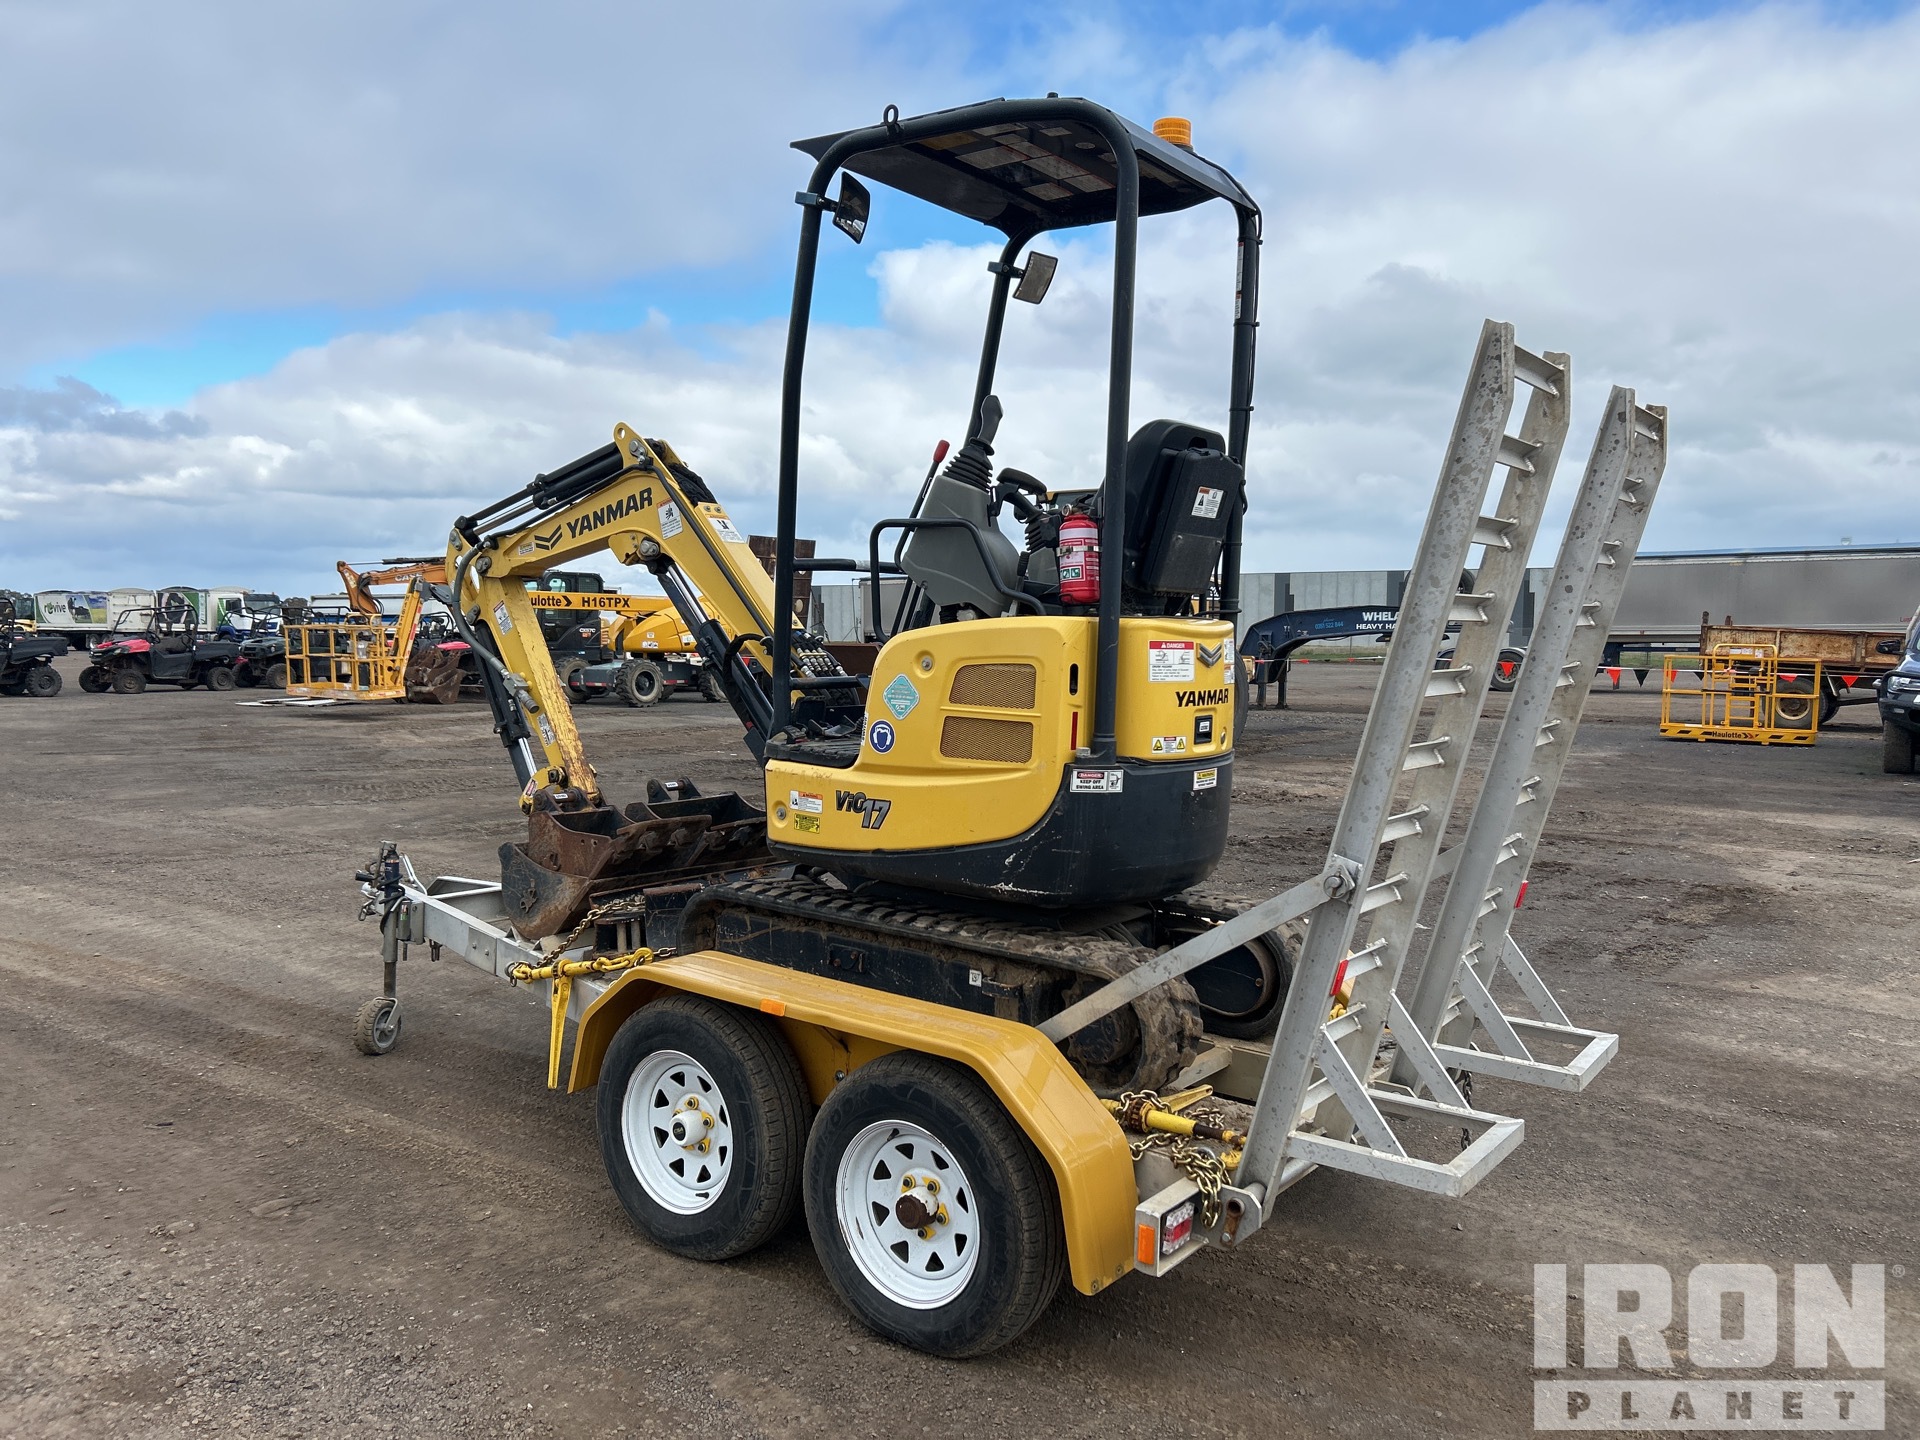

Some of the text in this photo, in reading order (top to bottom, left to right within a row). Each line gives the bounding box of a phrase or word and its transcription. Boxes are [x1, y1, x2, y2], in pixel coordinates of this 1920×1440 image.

[567, 487, 653, 539] YANMAR
[531, 595, 562, 606] ulotte
[582, 597, 630, 608] H16TPX
[44, 602, 66, 614] revive
[1362, 612, 1399, 621] WHELA
[1175, 688, 1229, 707] YANMAR
